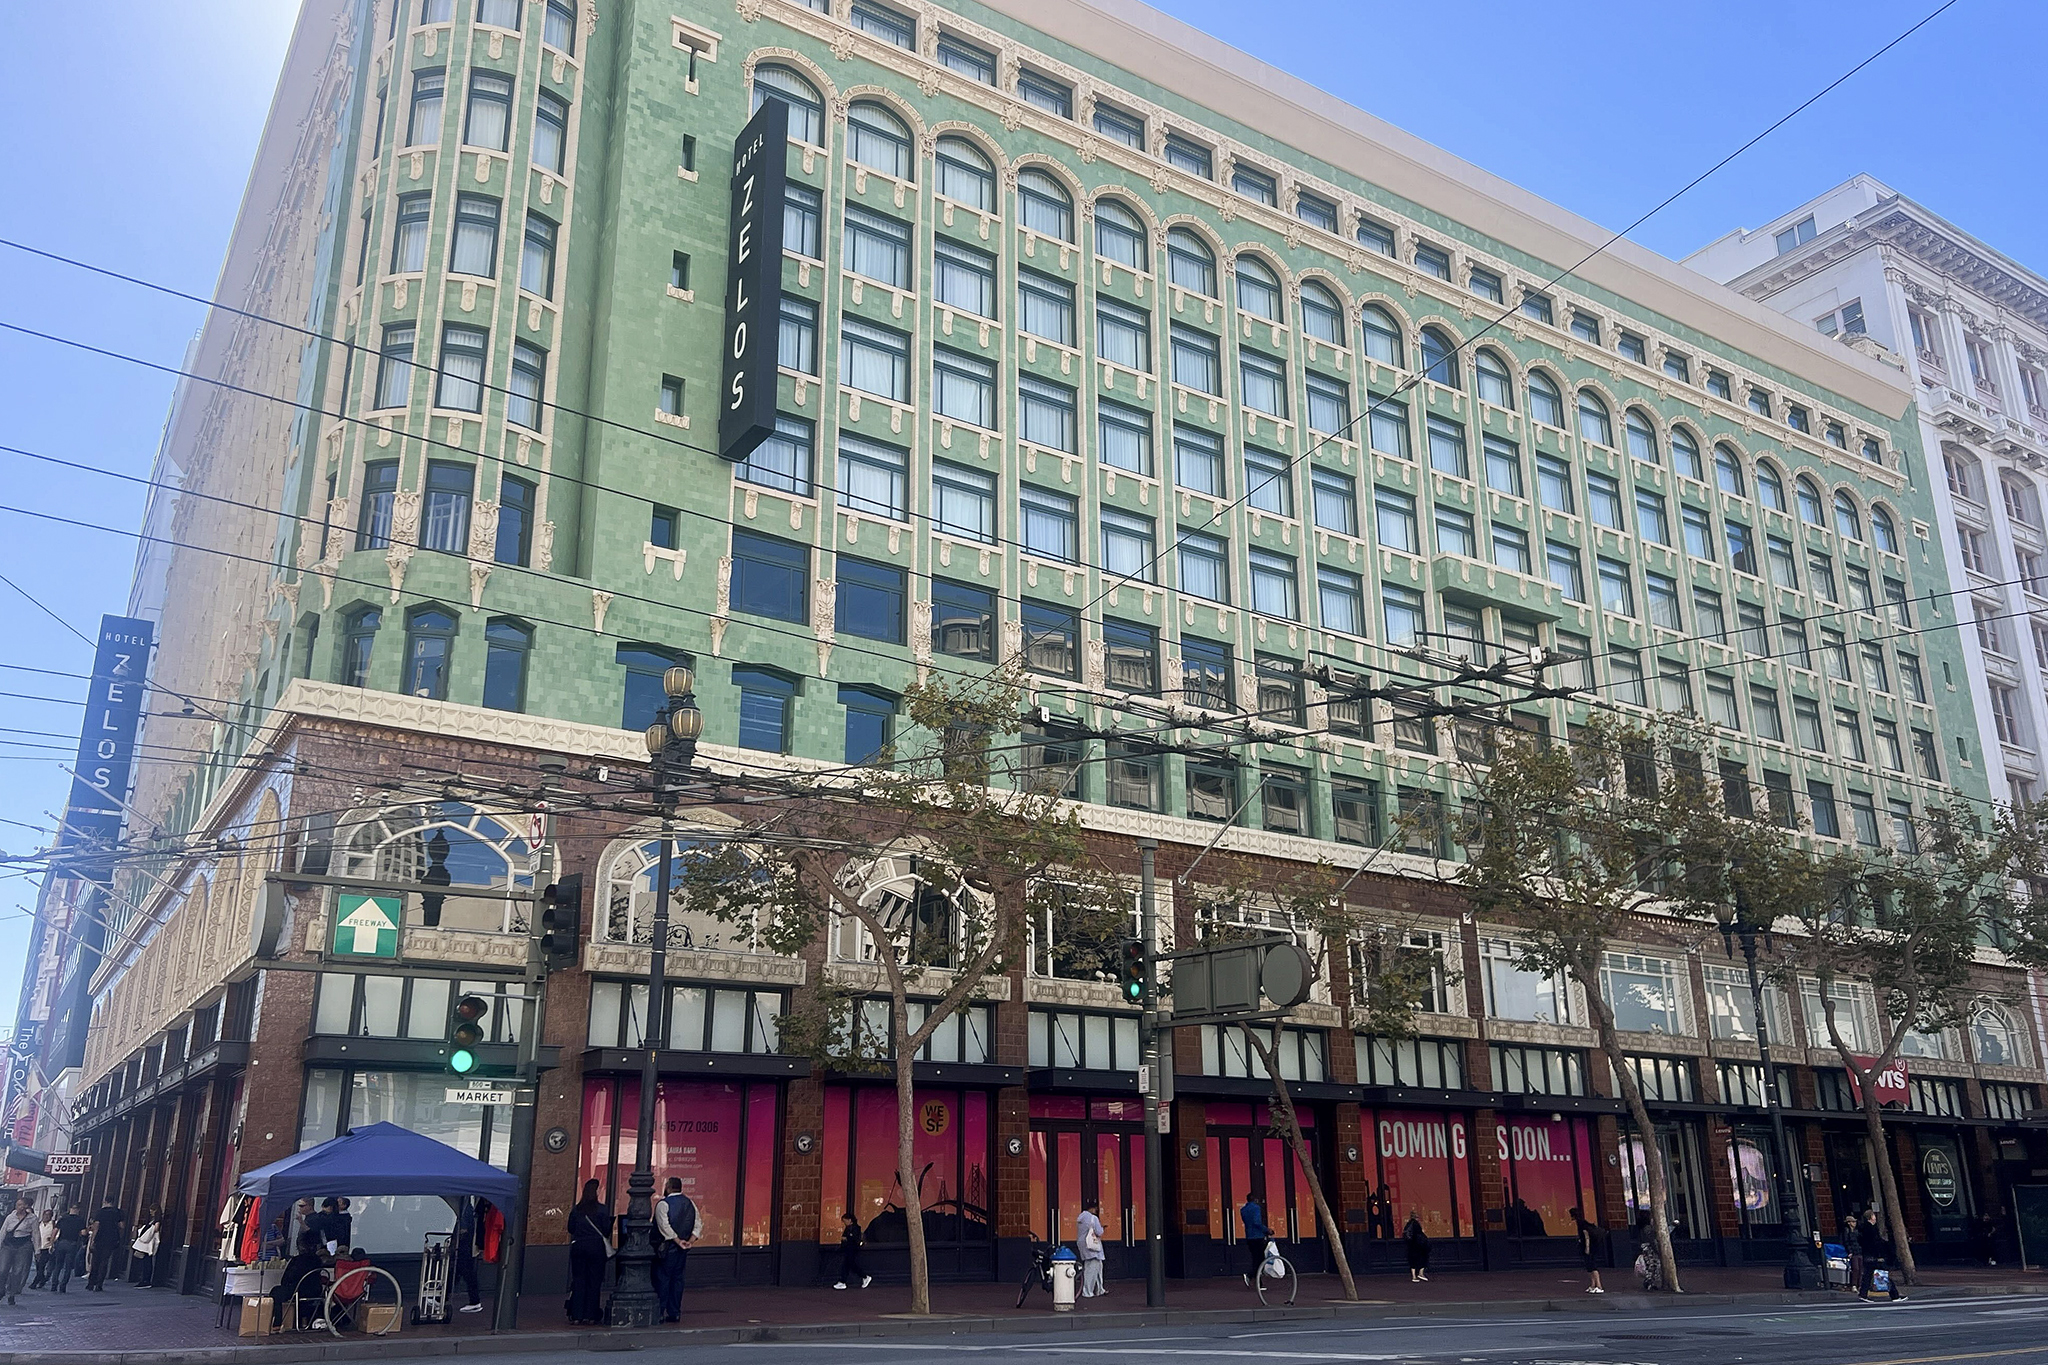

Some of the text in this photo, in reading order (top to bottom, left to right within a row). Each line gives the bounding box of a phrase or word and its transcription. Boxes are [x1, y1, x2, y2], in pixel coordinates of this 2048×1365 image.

[735, 132, 764, 177] HOTEL
[730, 173, 756, 411] ZELOS
[105, 632, 146, 646] HOTEL
[92, 653, 130, 789] ZELOS
[348, 918, 387, 927] FREEWAY
[18, 1026, 35, 1050] The
[456, 1092, 504, 1102] MARKET
[925, 1104, 944, 1117] WE
[678, 1120, 694, 1133] 772
[695, 1121, 719, 1133] 0306
[926, 1118, 944, 1132] SF
[1379, 1120, 1466, 1159] COMING
[50, 1156, 89, 1165] TRADER
[54, 1164, 83, 1173] JOE'S
[1926, 1162, 1949, 1175] LEVI'S
